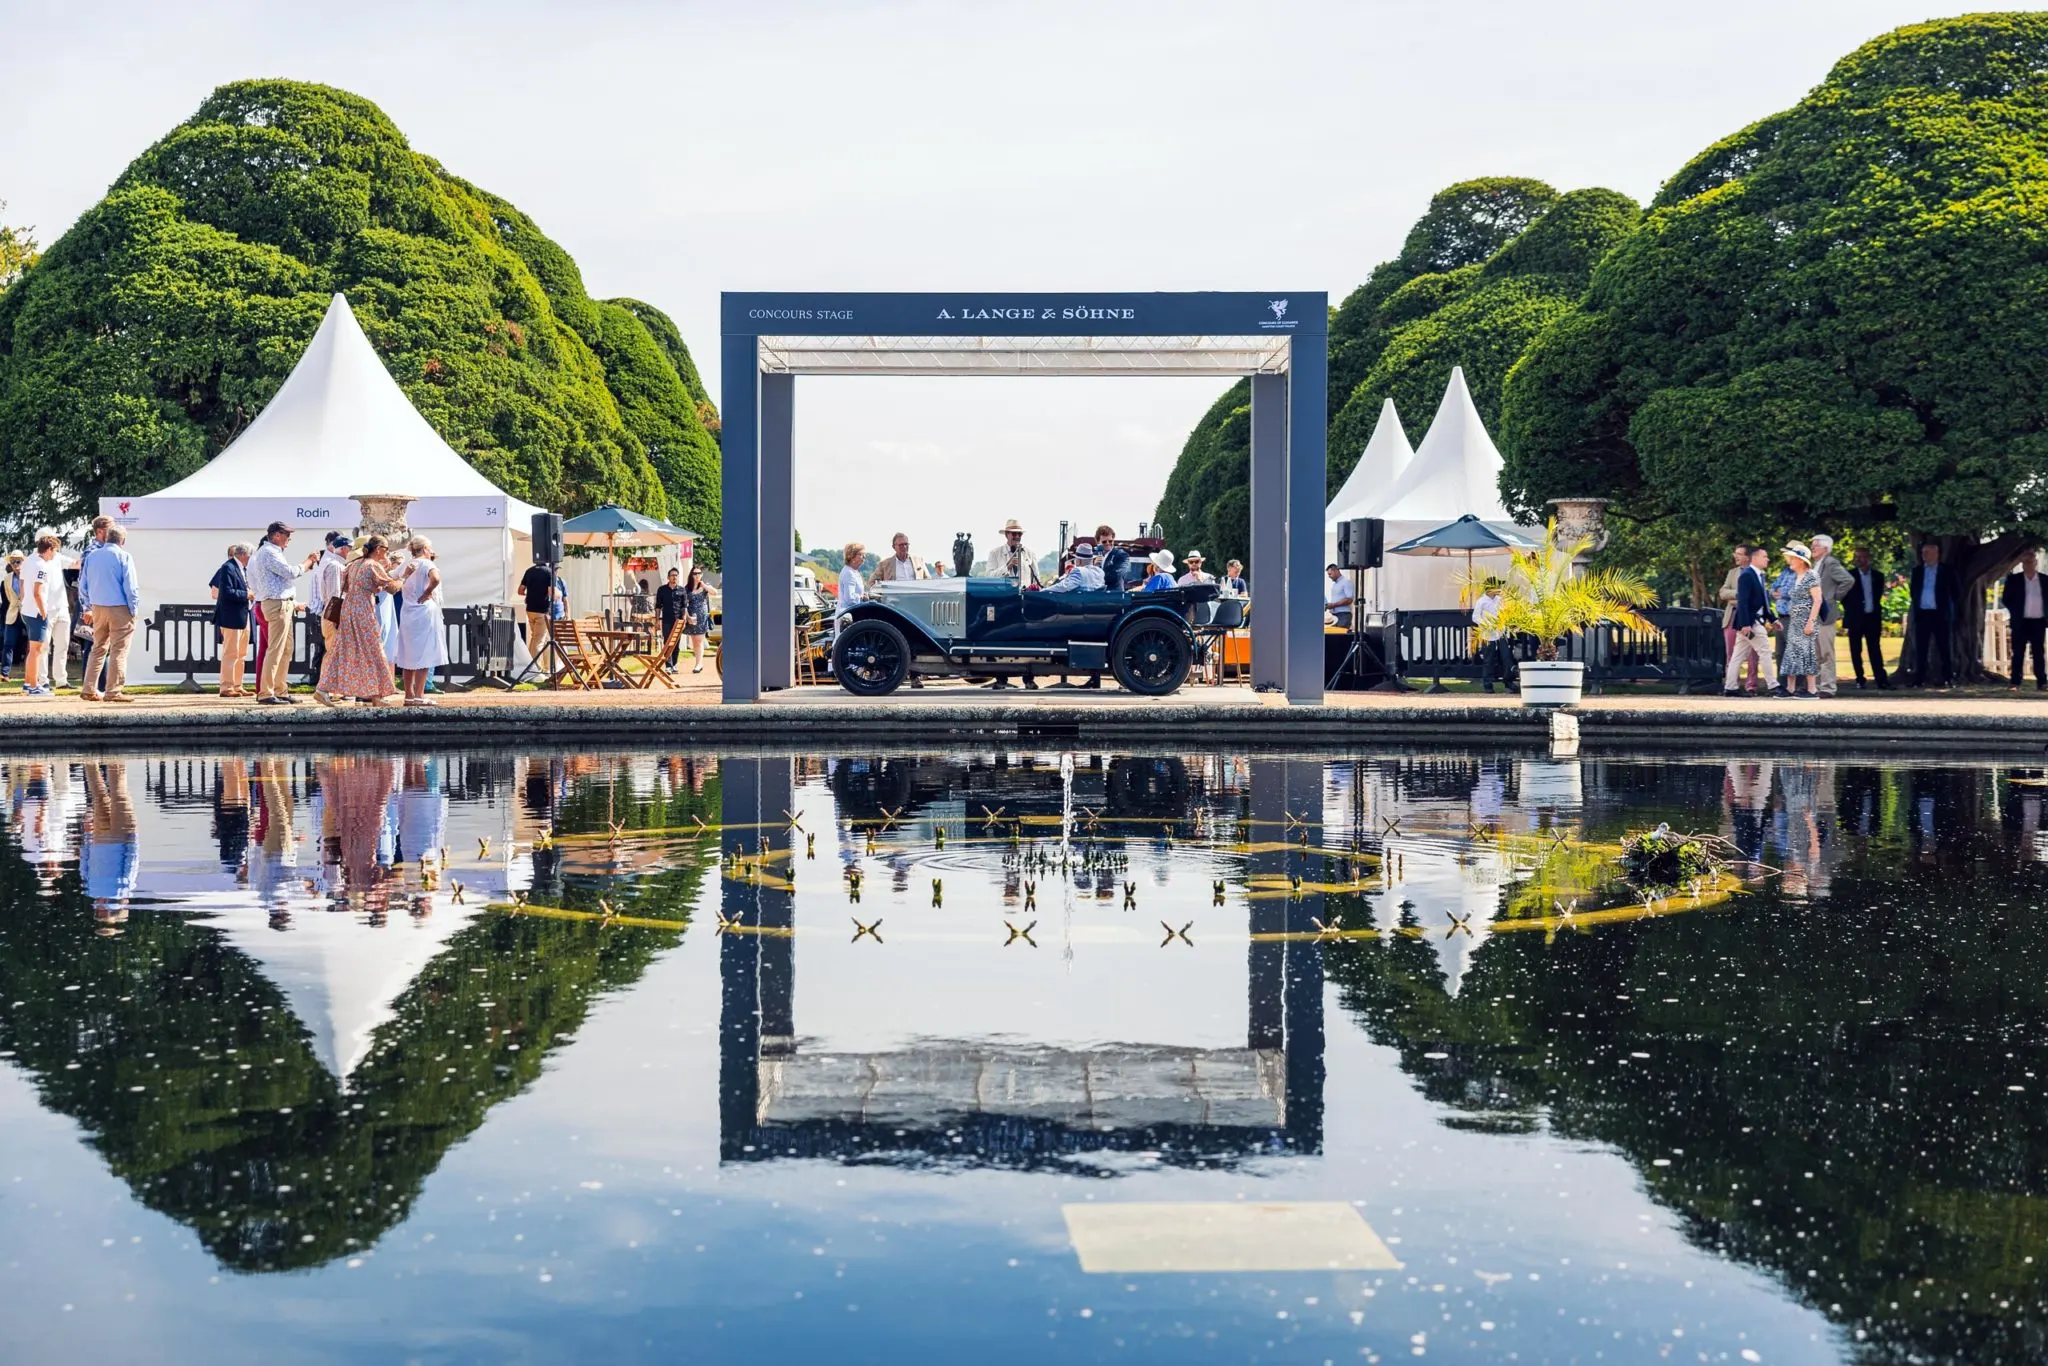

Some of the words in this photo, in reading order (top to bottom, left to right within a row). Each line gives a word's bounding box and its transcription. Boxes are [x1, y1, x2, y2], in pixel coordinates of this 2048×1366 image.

[749, 309, 813, 319] CONCOURS
[816, 310, 854, 320] STAGE
[936, 308, 956, 320] A.
[962, 308, 1035, 320] LANGE
[1041, 308, 1057, 320] &
[1062, 305, 1135, 320] SÖHNE
[296, 507, 330, 518] Rodin
[486, 507, 497, 516] 34
